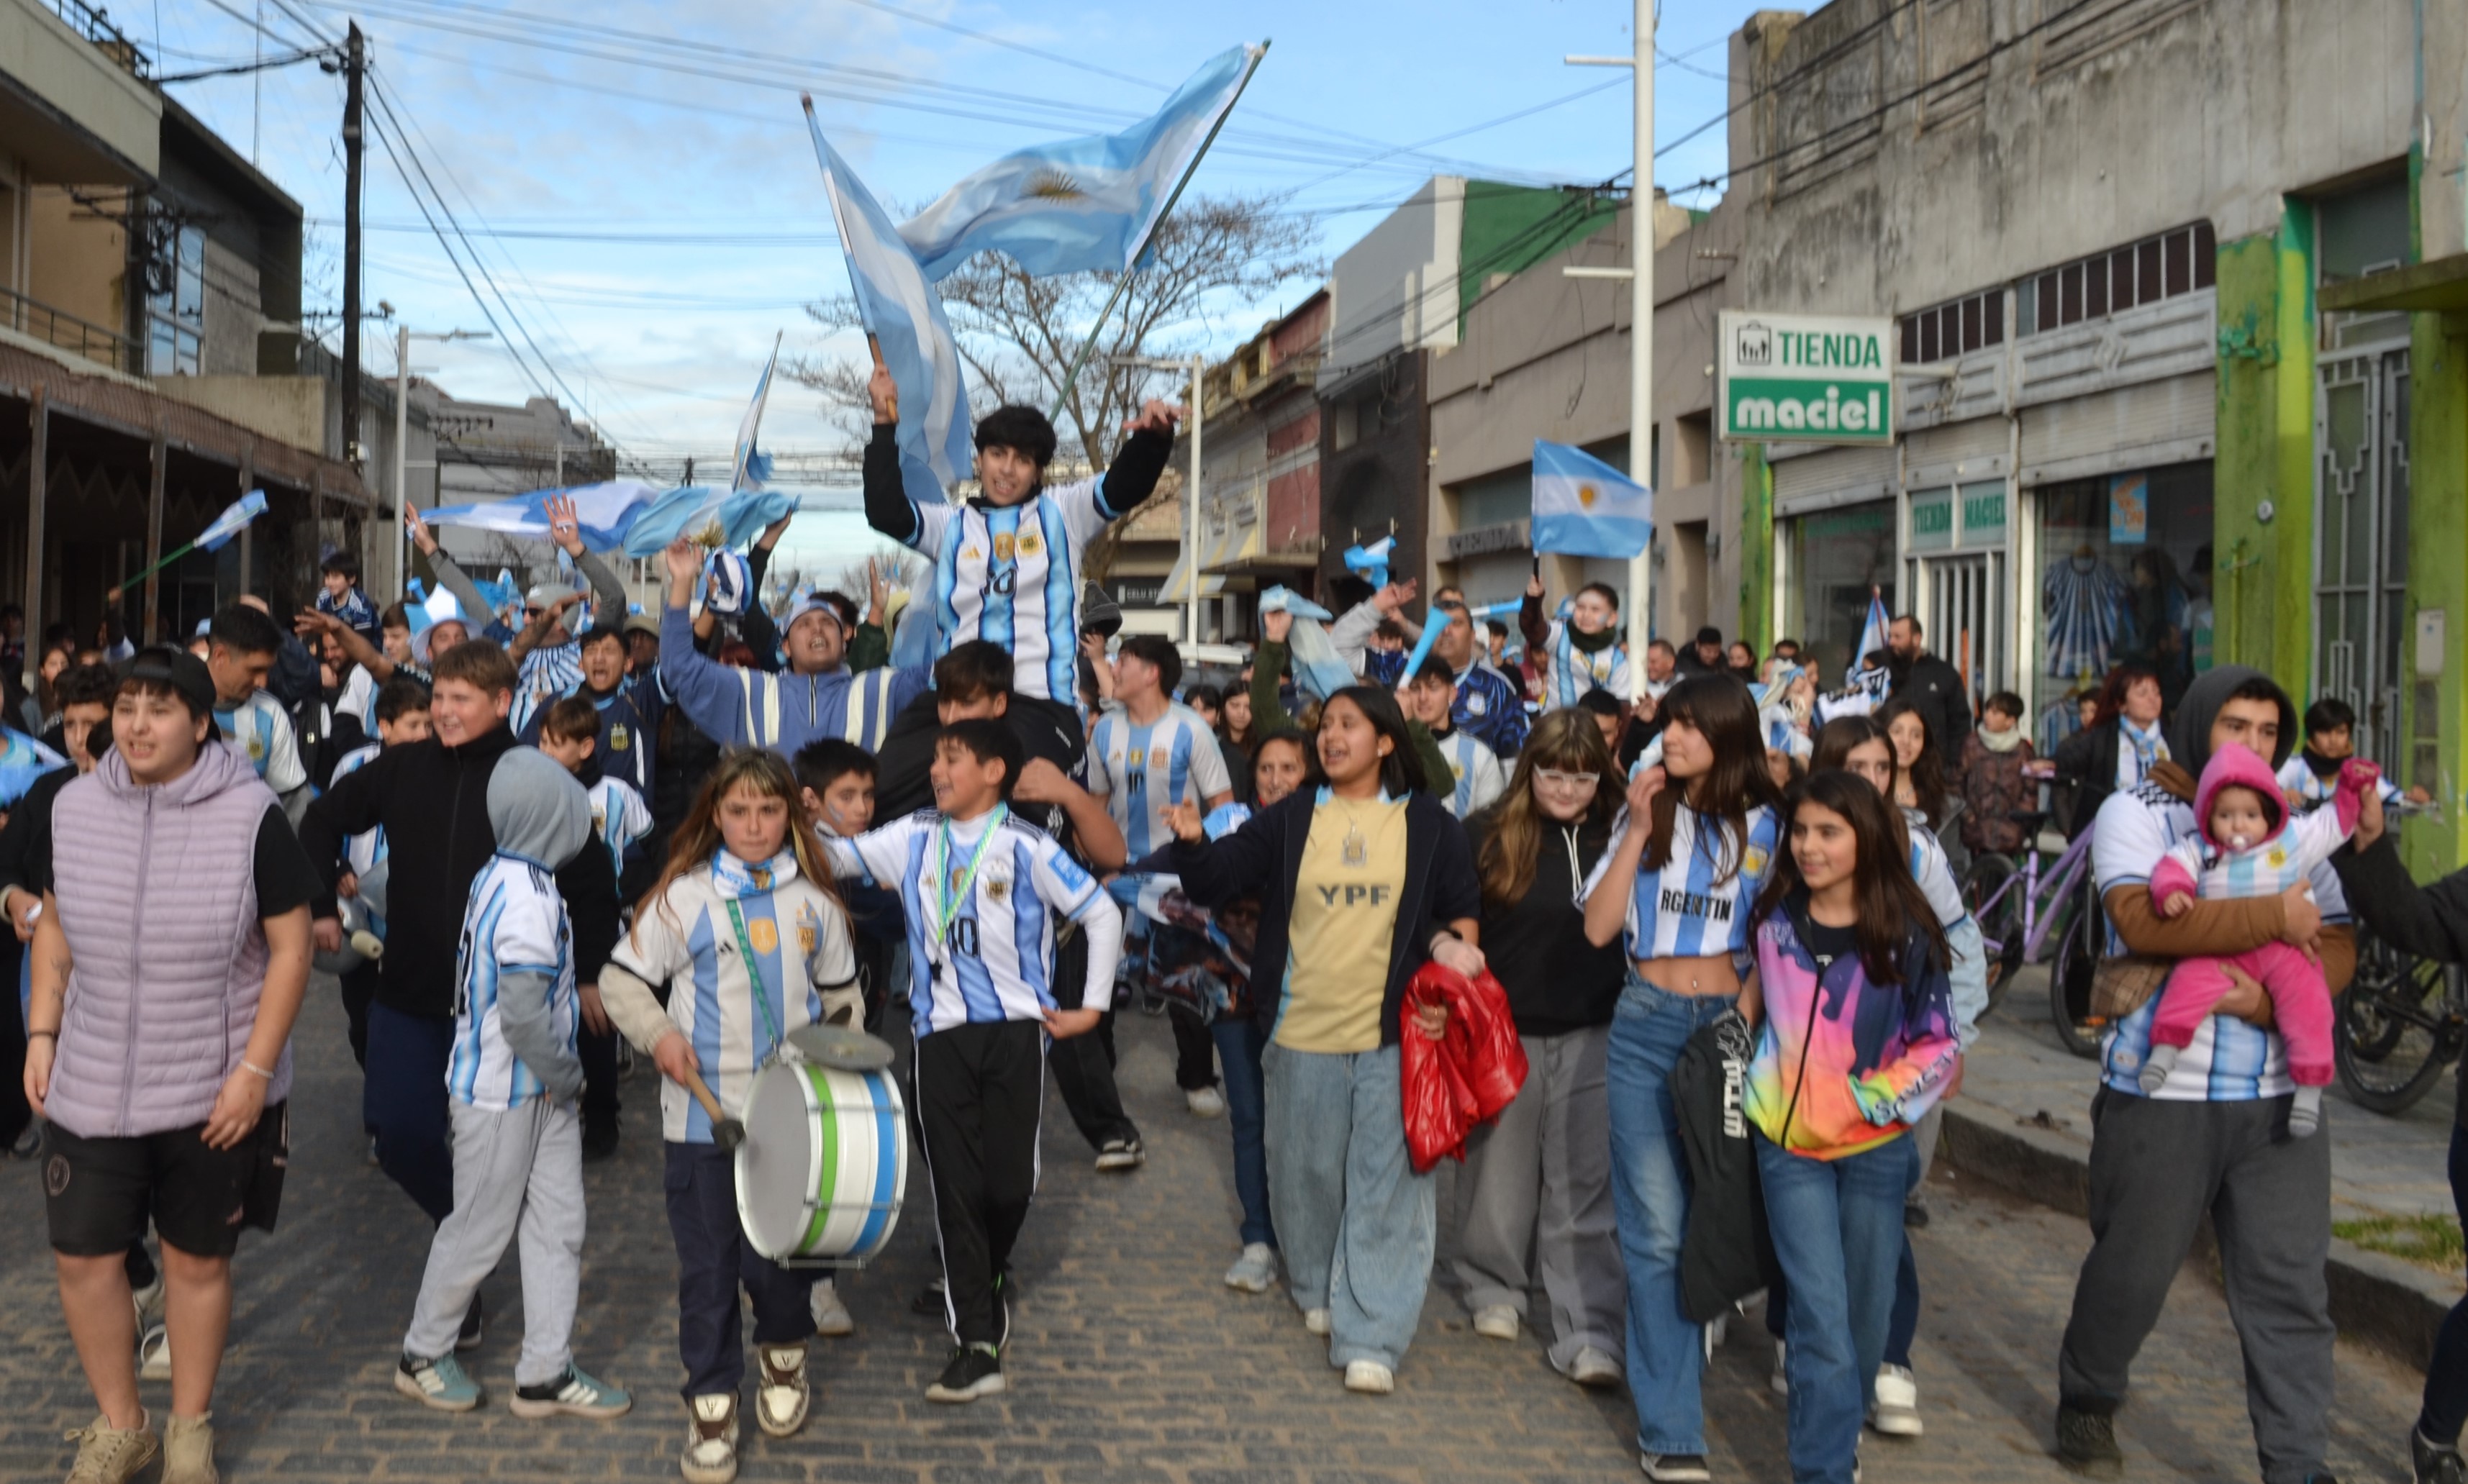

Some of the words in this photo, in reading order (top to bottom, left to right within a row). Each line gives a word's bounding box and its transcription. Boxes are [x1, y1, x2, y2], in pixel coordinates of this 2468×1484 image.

[1777, 331, 1881, 369] TIENDA
[1736, 385, 1880, 431] maciel
[1316, 883, 1391, 907] YPF
